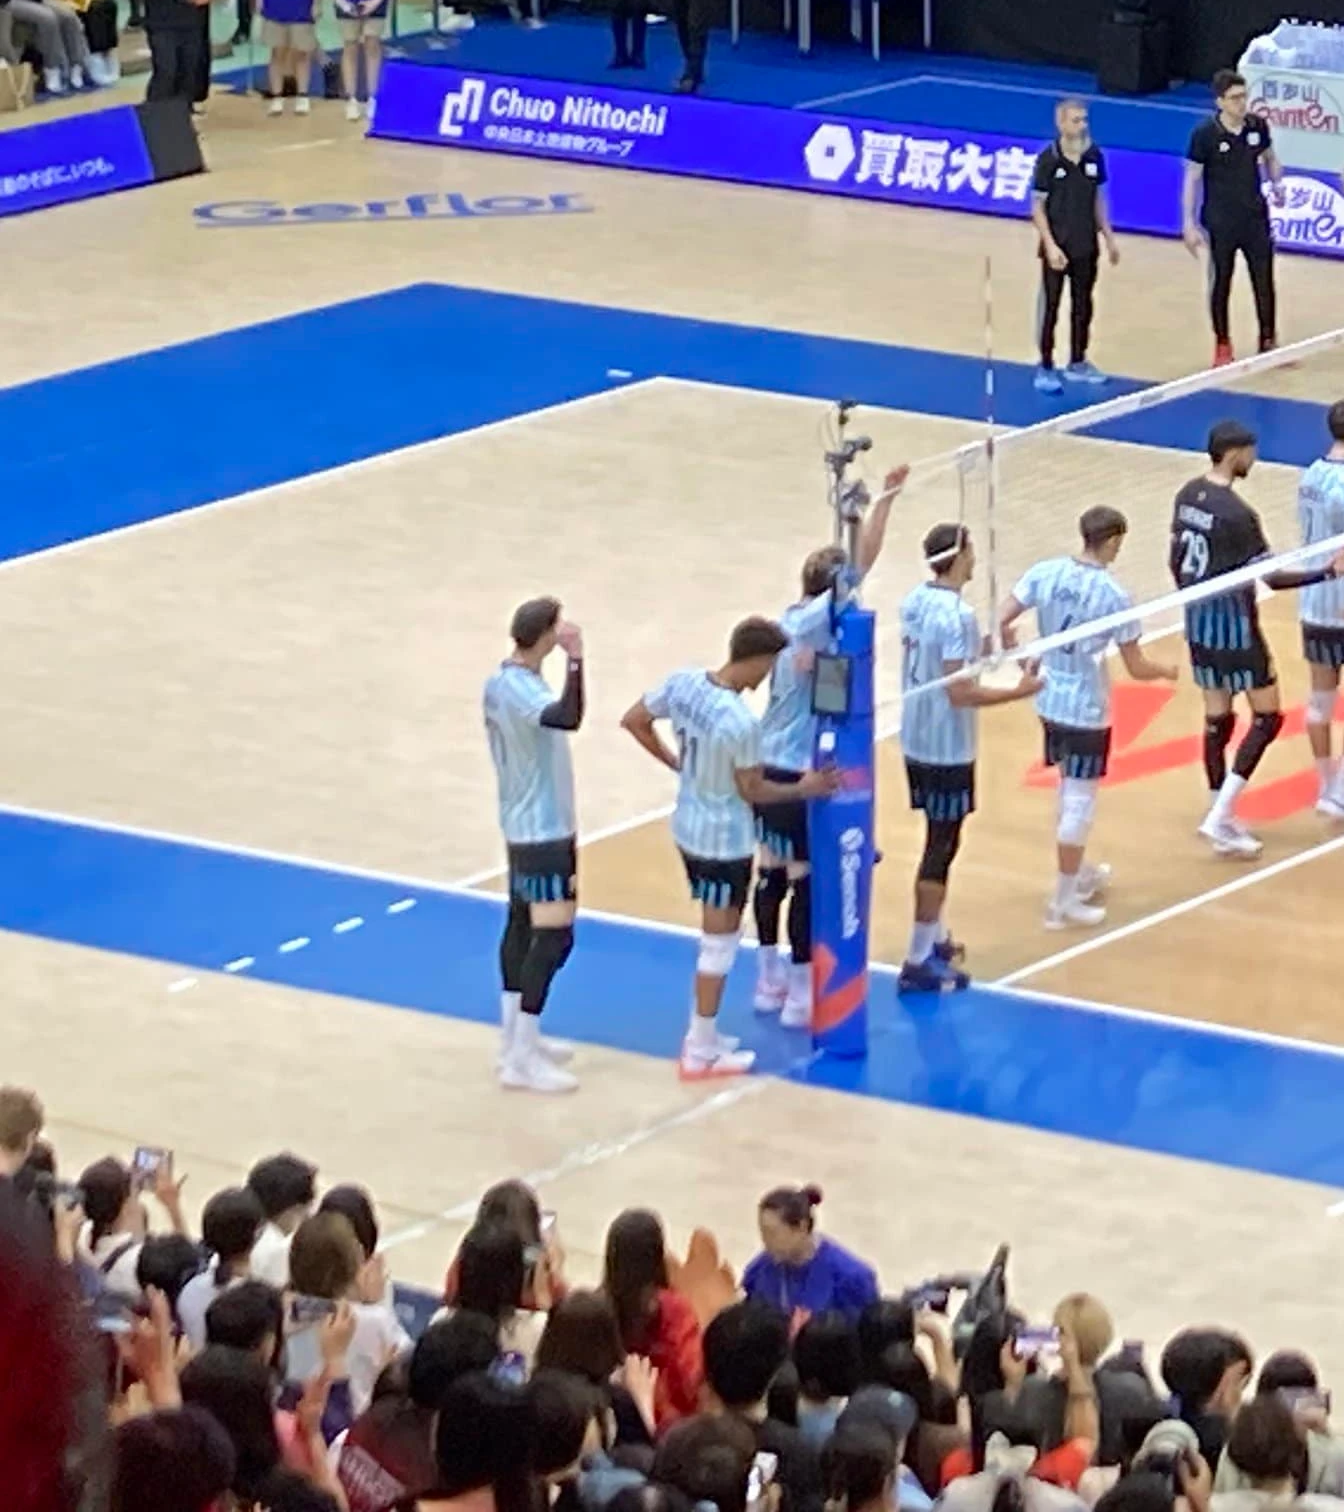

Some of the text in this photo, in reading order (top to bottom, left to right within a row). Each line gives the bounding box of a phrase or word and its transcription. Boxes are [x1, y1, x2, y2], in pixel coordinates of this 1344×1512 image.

[489, 86, 670, 137] Chuo Nittochi
[855, 129, 1039, 202] 買取大吉
